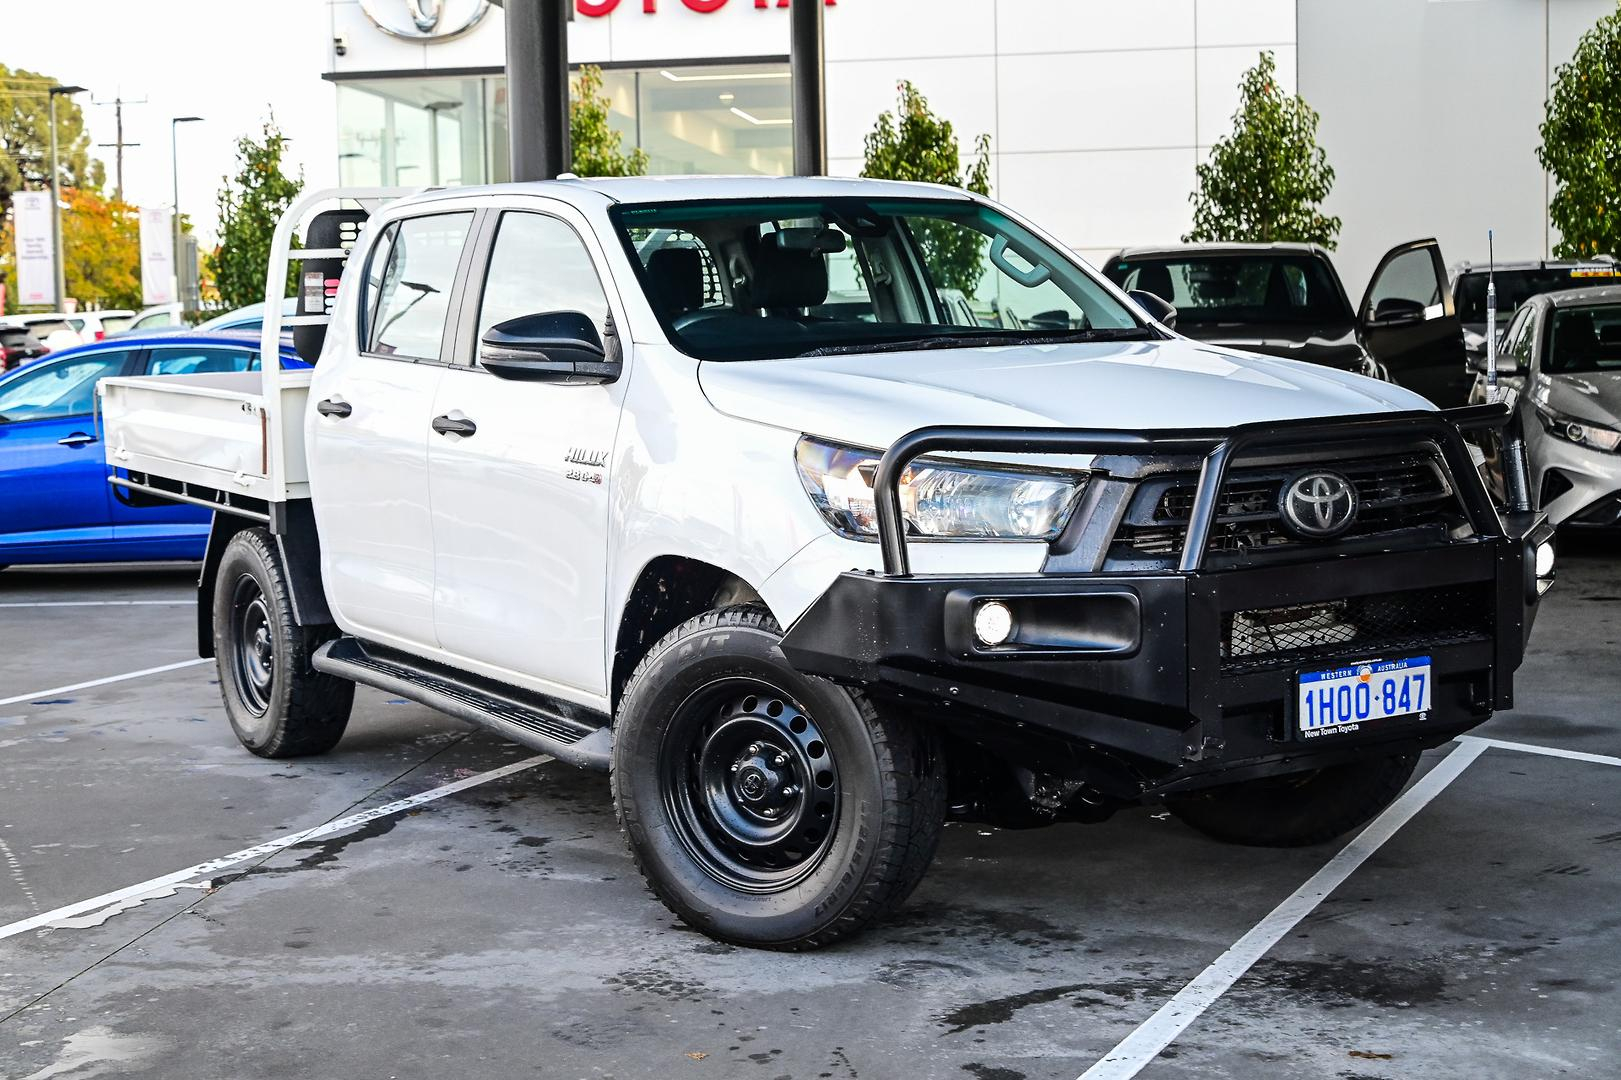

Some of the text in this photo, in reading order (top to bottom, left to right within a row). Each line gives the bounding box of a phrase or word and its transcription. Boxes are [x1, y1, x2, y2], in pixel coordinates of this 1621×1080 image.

[1321, 670, 1352, 679] WESTERN
[1378, 662, 1408, 671] AUSTRALIA
[1304, 723, 1359, 738] New Town Toyota
